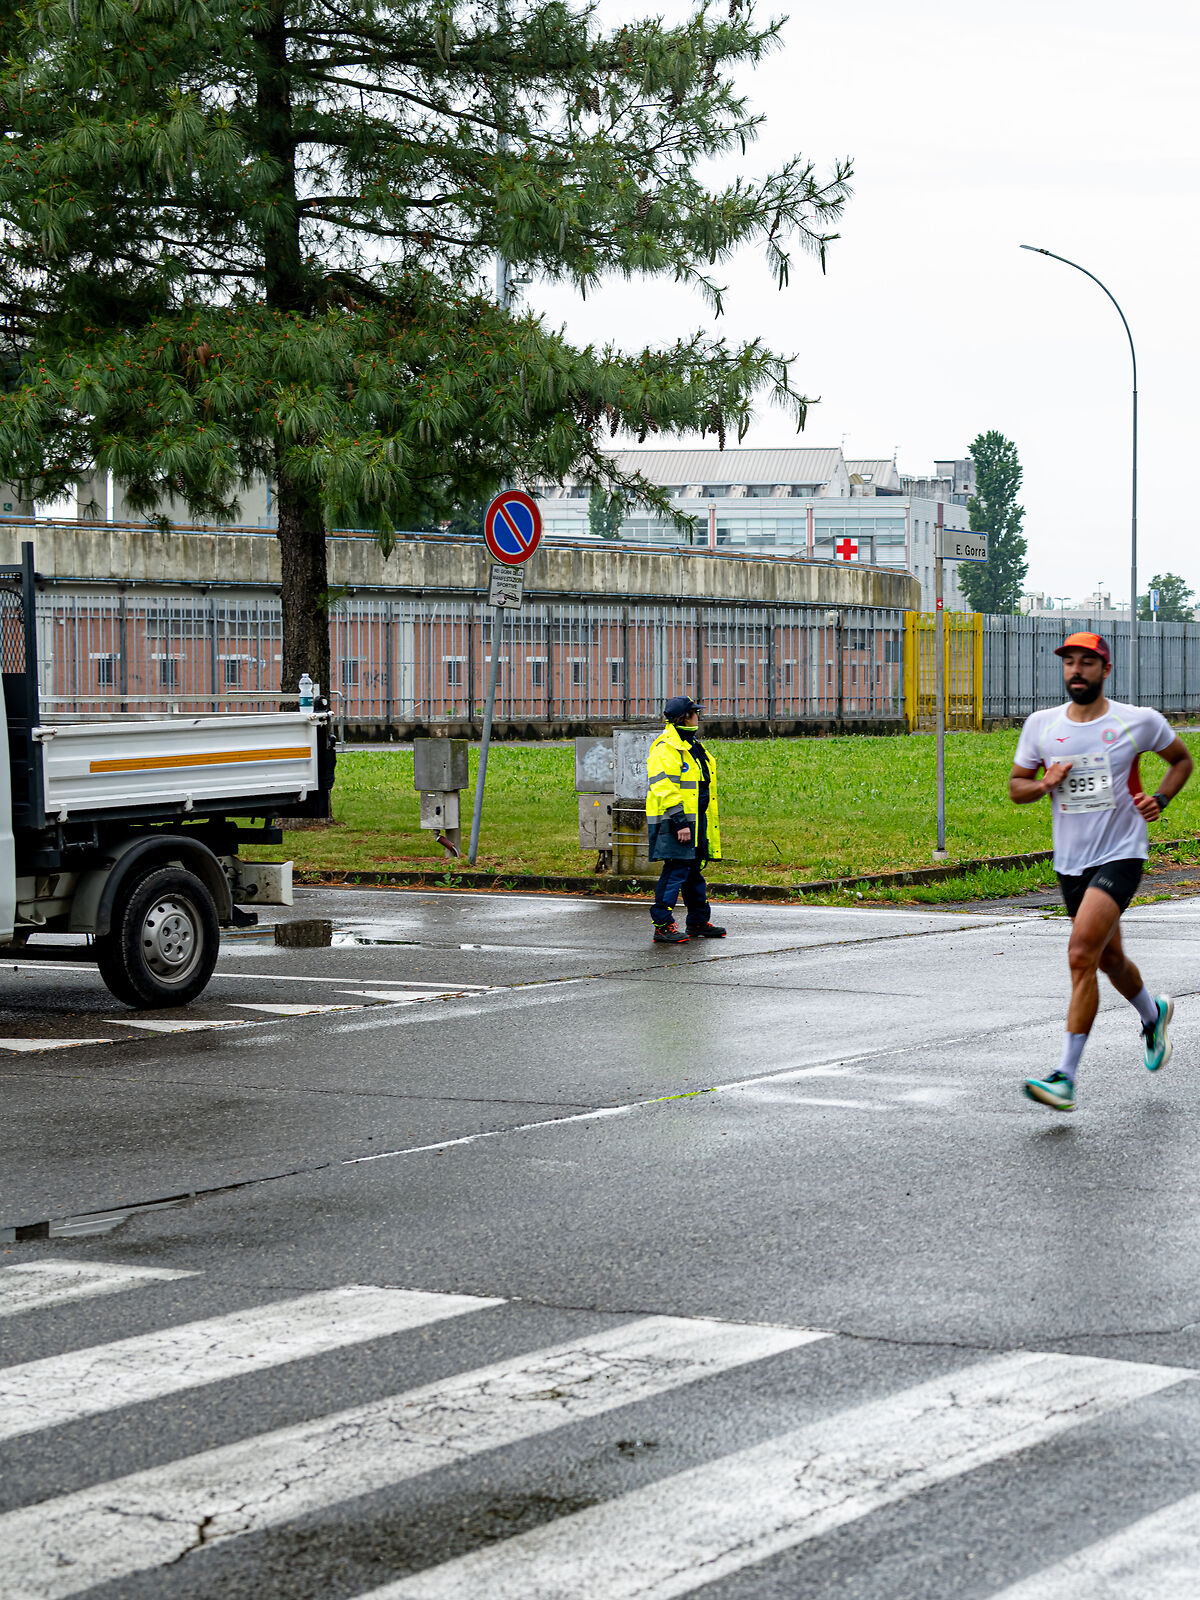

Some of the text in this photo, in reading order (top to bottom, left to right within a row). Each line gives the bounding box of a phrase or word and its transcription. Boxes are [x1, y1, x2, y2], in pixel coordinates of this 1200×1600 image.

[956, 544, 986, 557] E. Gorra
[1069, 777, 1095, 793] 995
